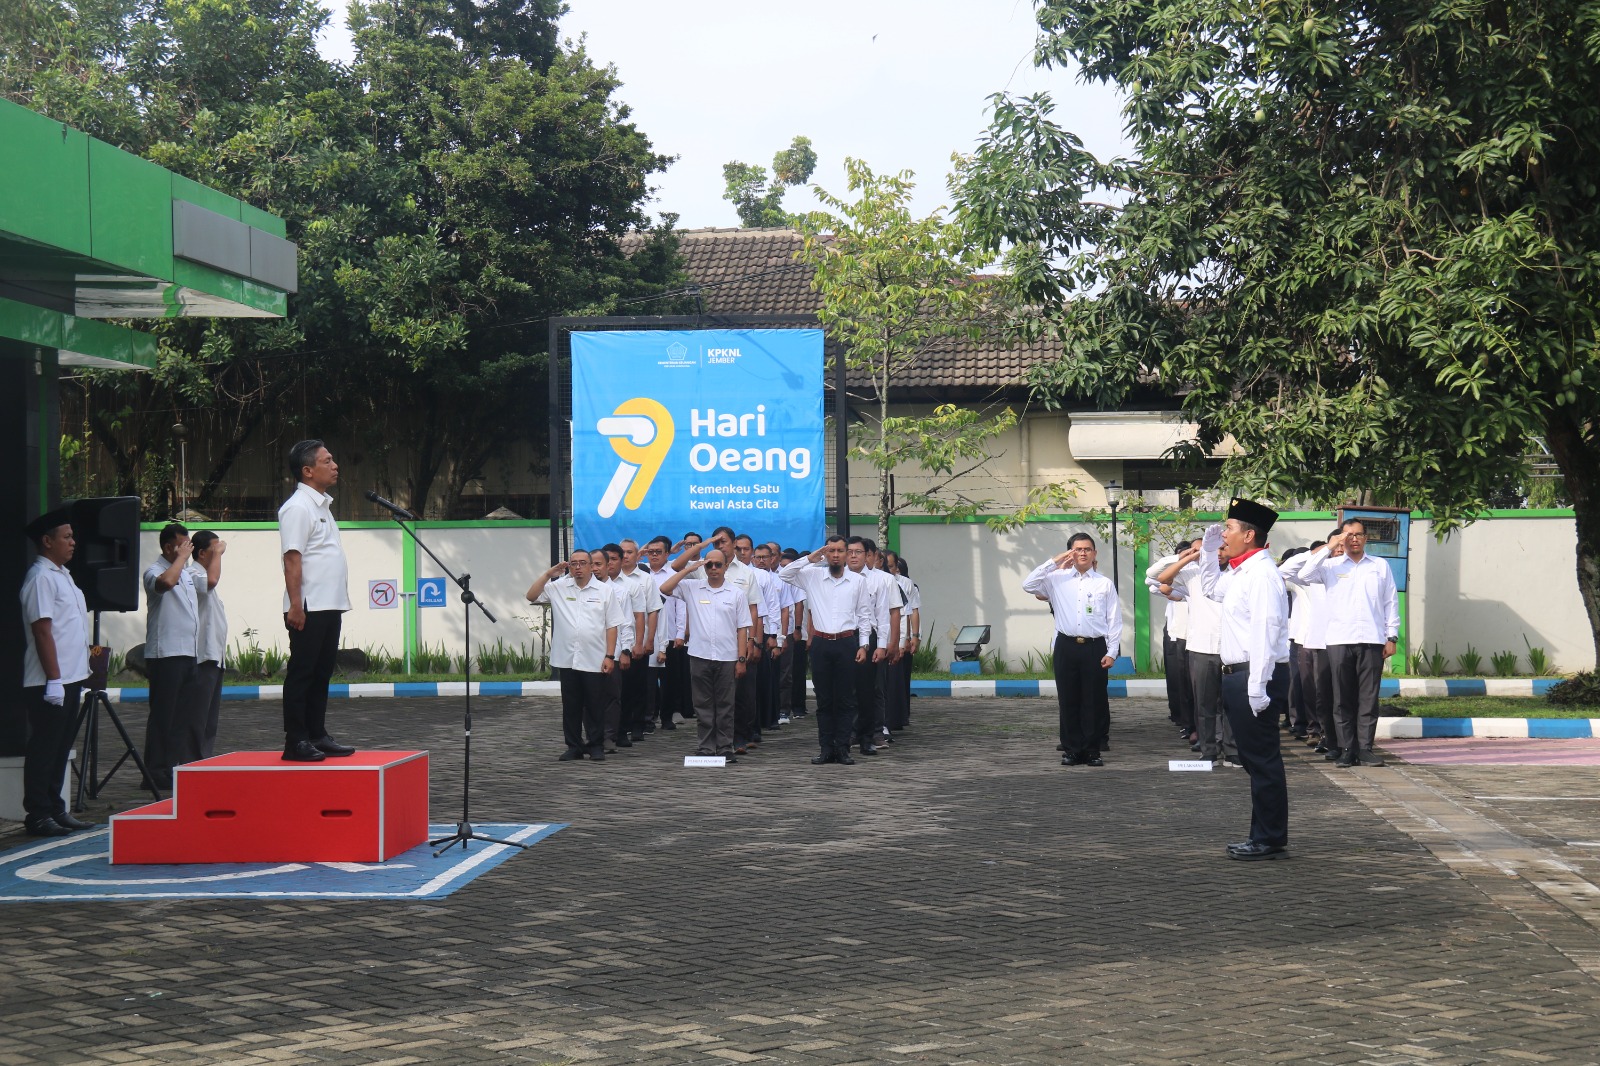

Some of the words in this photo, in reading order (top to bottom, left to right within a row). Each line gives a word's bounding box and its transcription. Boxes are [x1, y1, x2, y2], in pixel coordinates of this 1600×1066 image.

[707, 348, 742, 357] KPKNL
[691, 404, 765, 437] Hari
[689, 443, 811, 479] Oeang
[689, 484, 751, 494] Kemenkeu
[753, 484, 780, 494] Satu
[690, 499, 725, 510] Kawal
[727, 499, 753, 509] Asta
[755, 499, 779, 509] Cita
